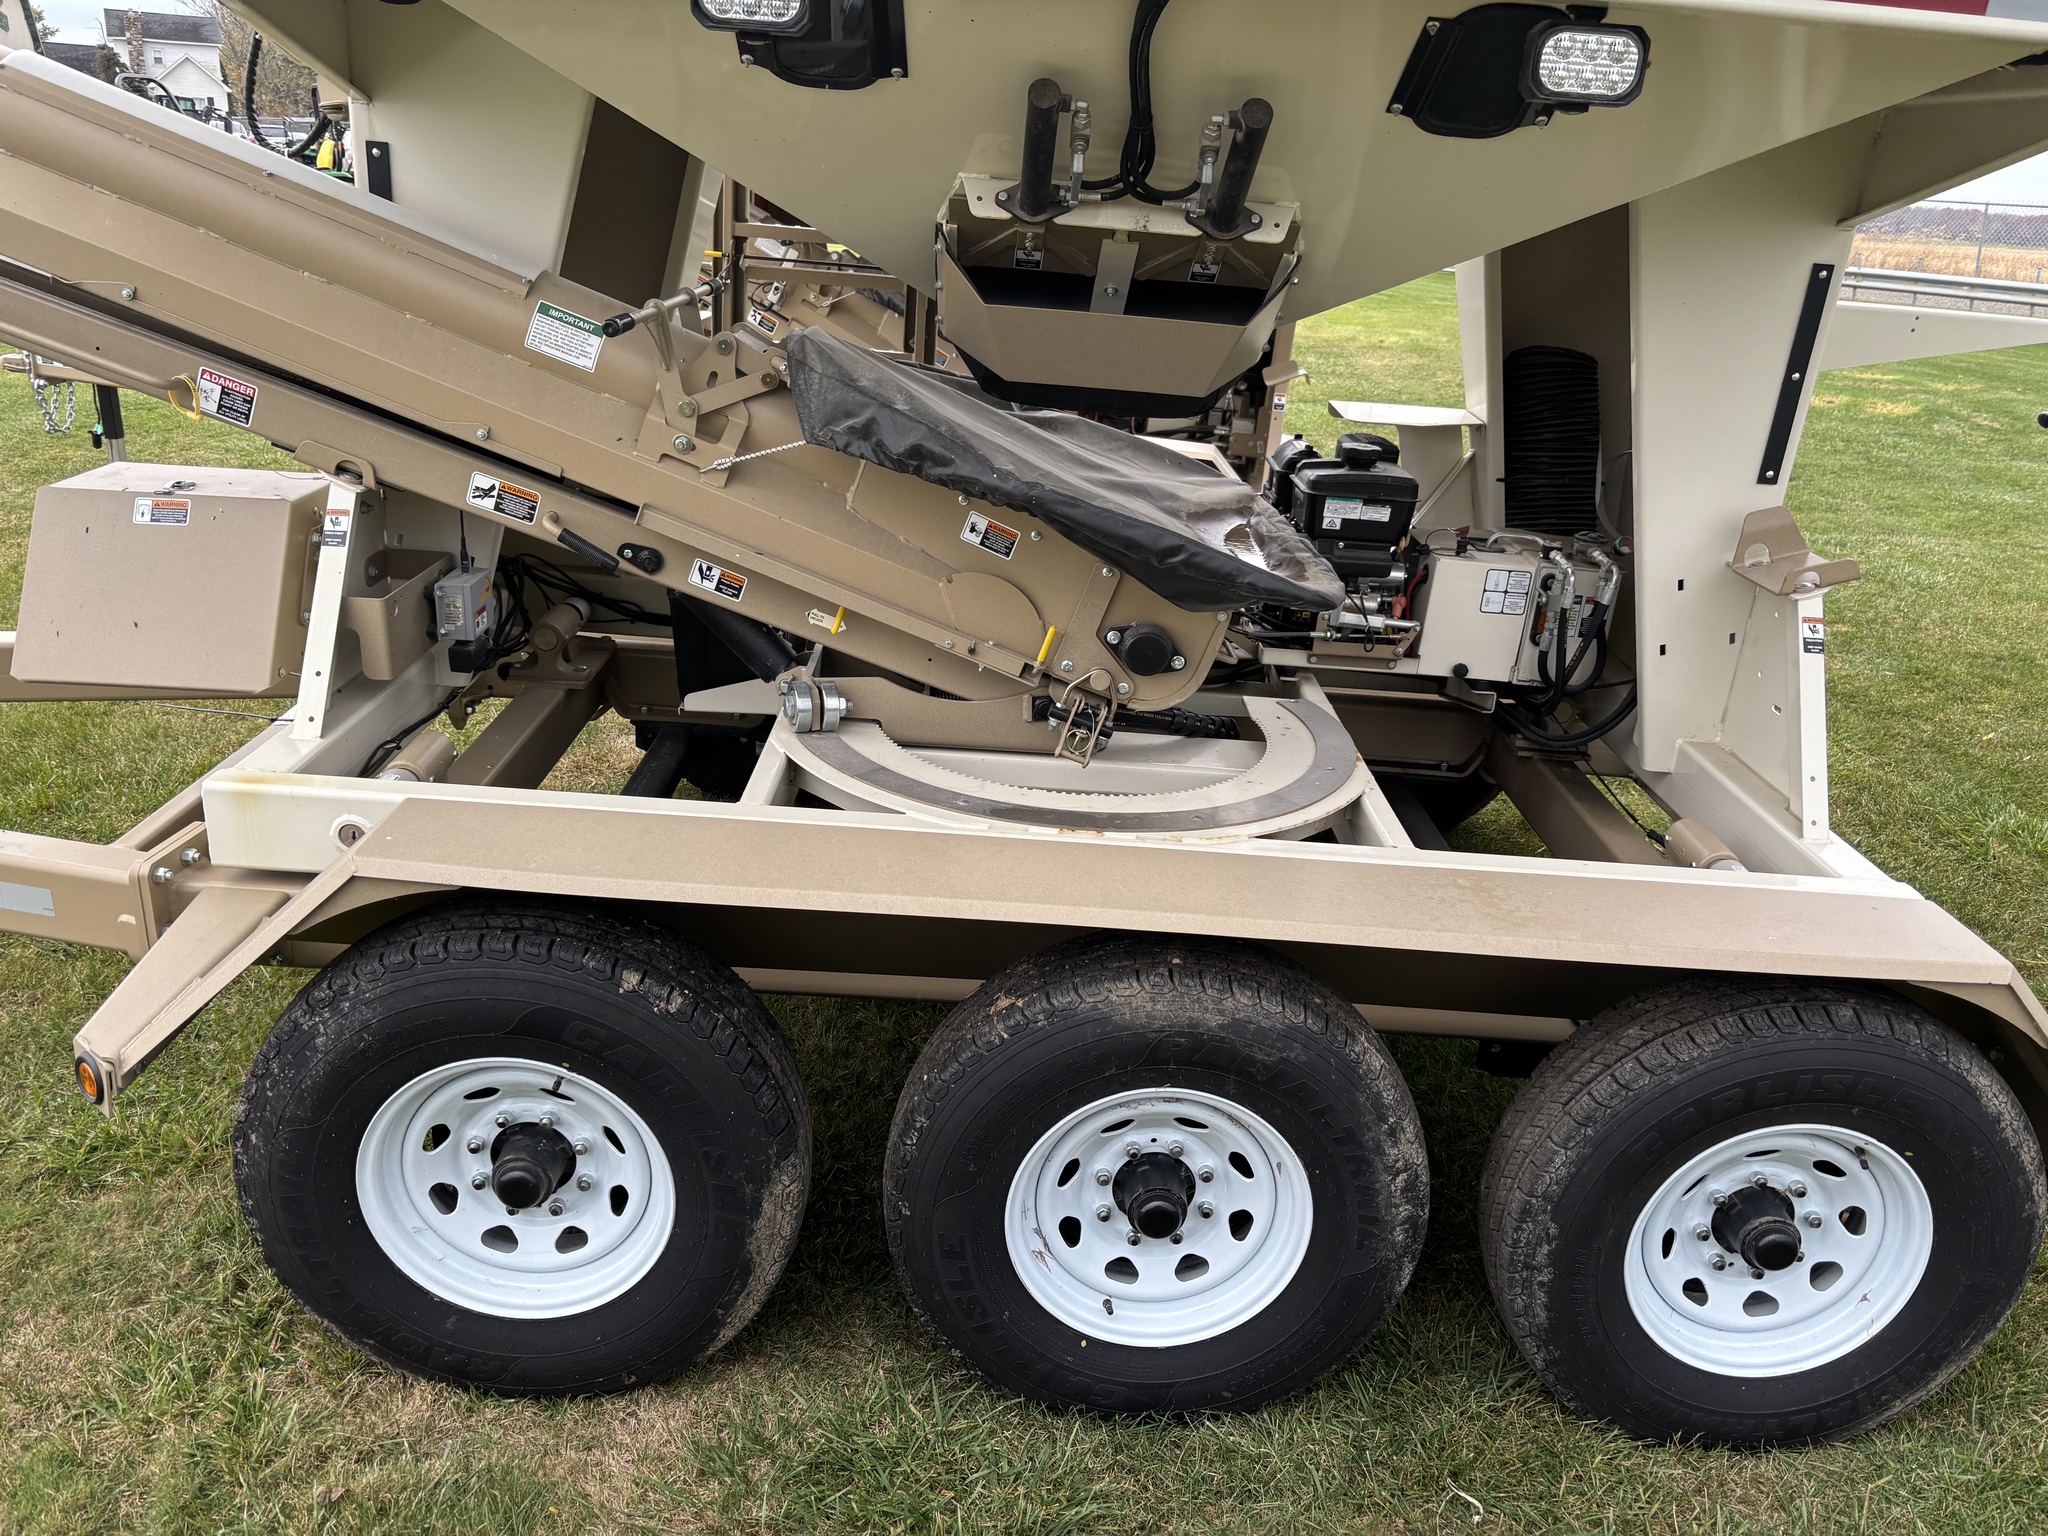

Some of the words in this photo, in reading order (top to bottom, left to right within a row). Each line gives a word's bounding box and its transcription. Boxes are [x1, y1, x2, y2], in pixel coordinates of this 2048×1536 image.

[547, 308, 595, 332] IMPORTANT
[210, 374, 254, 396] DANGER
[506, 485, 538, 500] WARNING
[991, 524, 1017, 539] WARNING
[809, 615, 823, 623] UNLOCK
[1628, 1066, 1934, 1166] CARLISLE
[557, 1010, 745, 1247] CARLISLE
[929, 1229, 1131, 1409] CARLISLE
